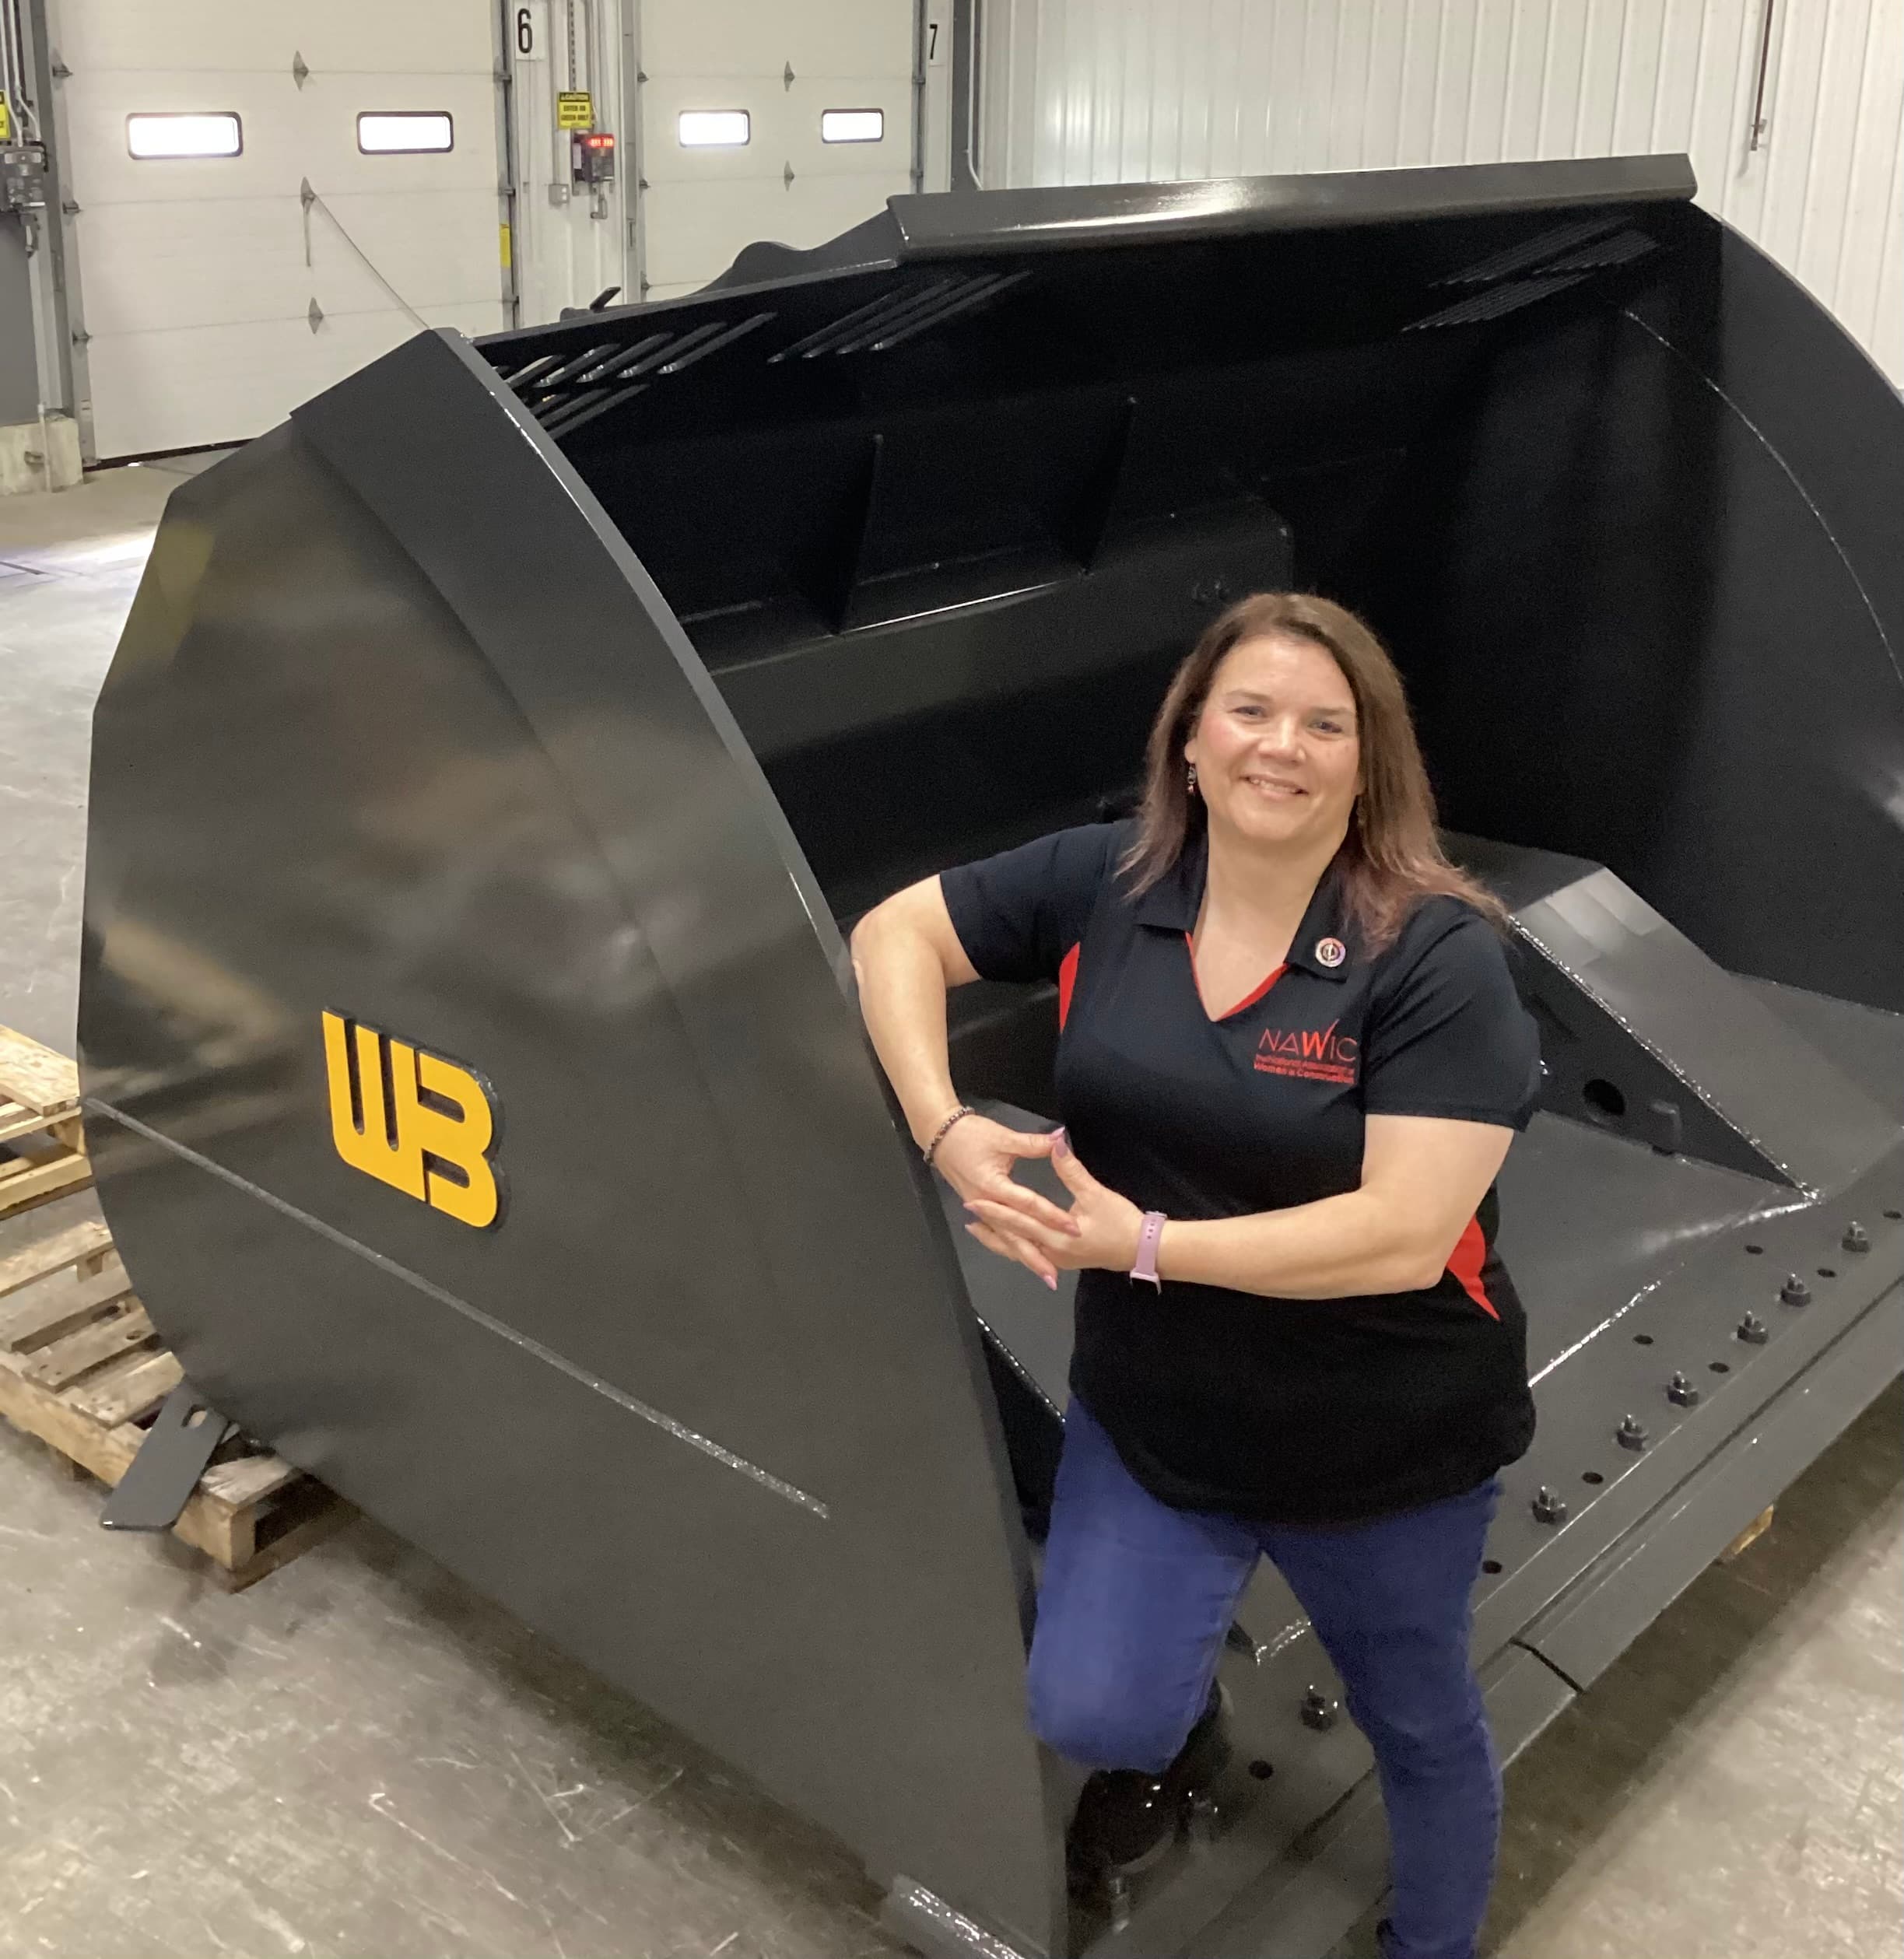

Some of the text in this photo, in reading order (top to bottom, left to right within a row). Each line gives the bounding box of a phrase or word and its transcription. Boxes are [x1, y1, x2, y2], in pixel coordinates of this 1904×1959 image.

[517, 8, 533, 54] 6
[929, 23, 938, 60] 7
[1258, 1018, 1358, 1062] NAWIC
[321, 1010, 498, 1228] WB
